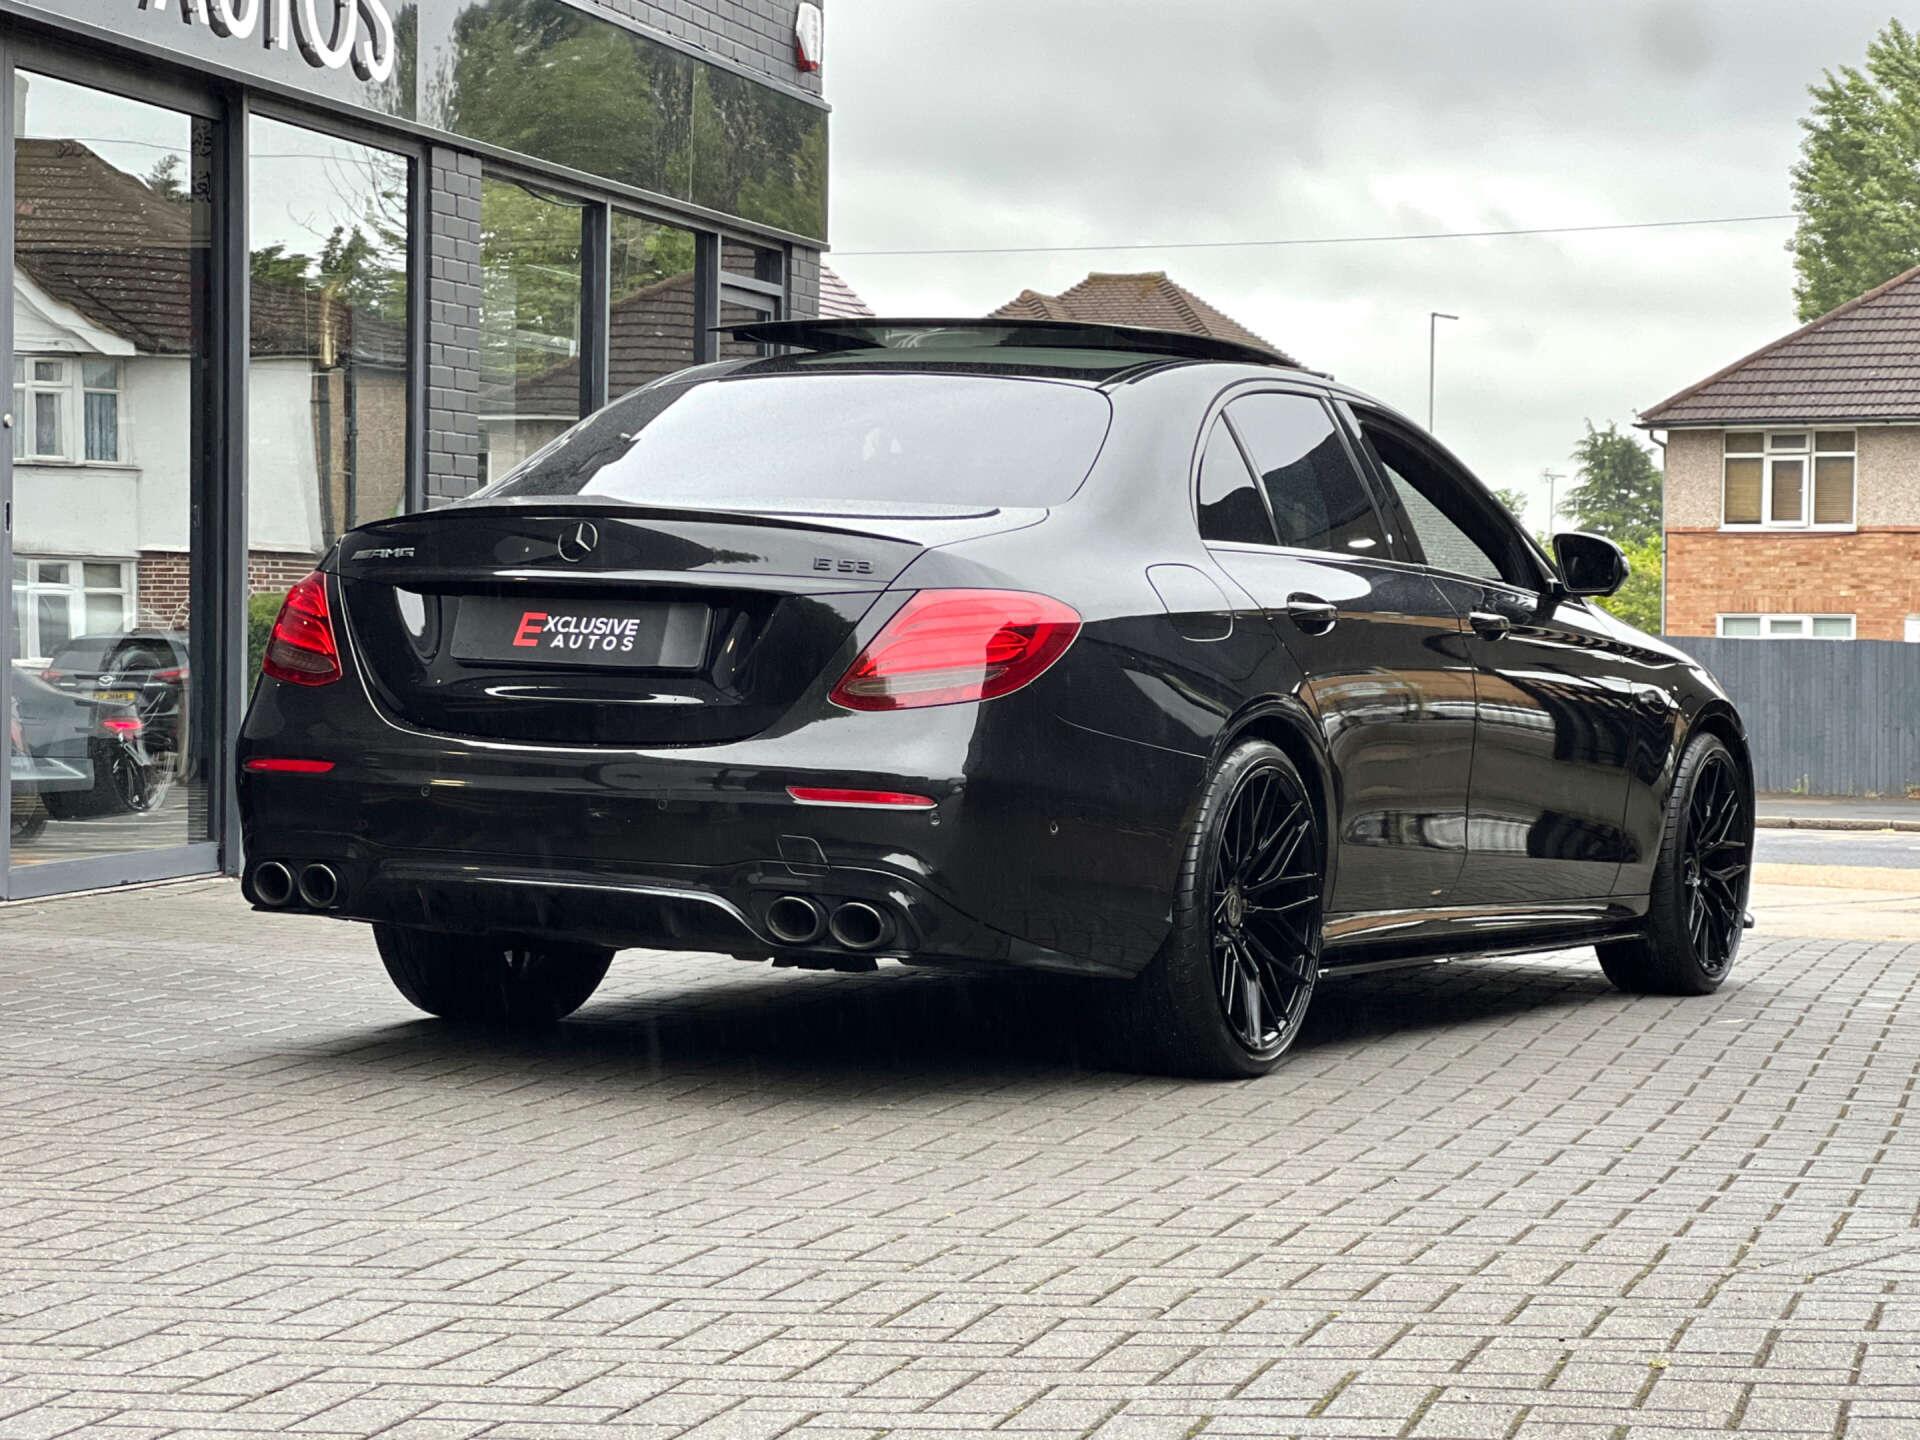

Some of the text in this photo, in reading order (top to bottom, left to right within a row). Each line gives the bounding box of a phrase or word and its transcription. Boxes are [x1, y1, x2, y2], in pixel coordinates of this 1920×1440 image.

[366, 547, 415, 559] AMG
[813, 558, 874, 574] E 53
[512, 611, 640, 647] EXCLUSIVE
[550, 634, 634, 652] AUTOS
